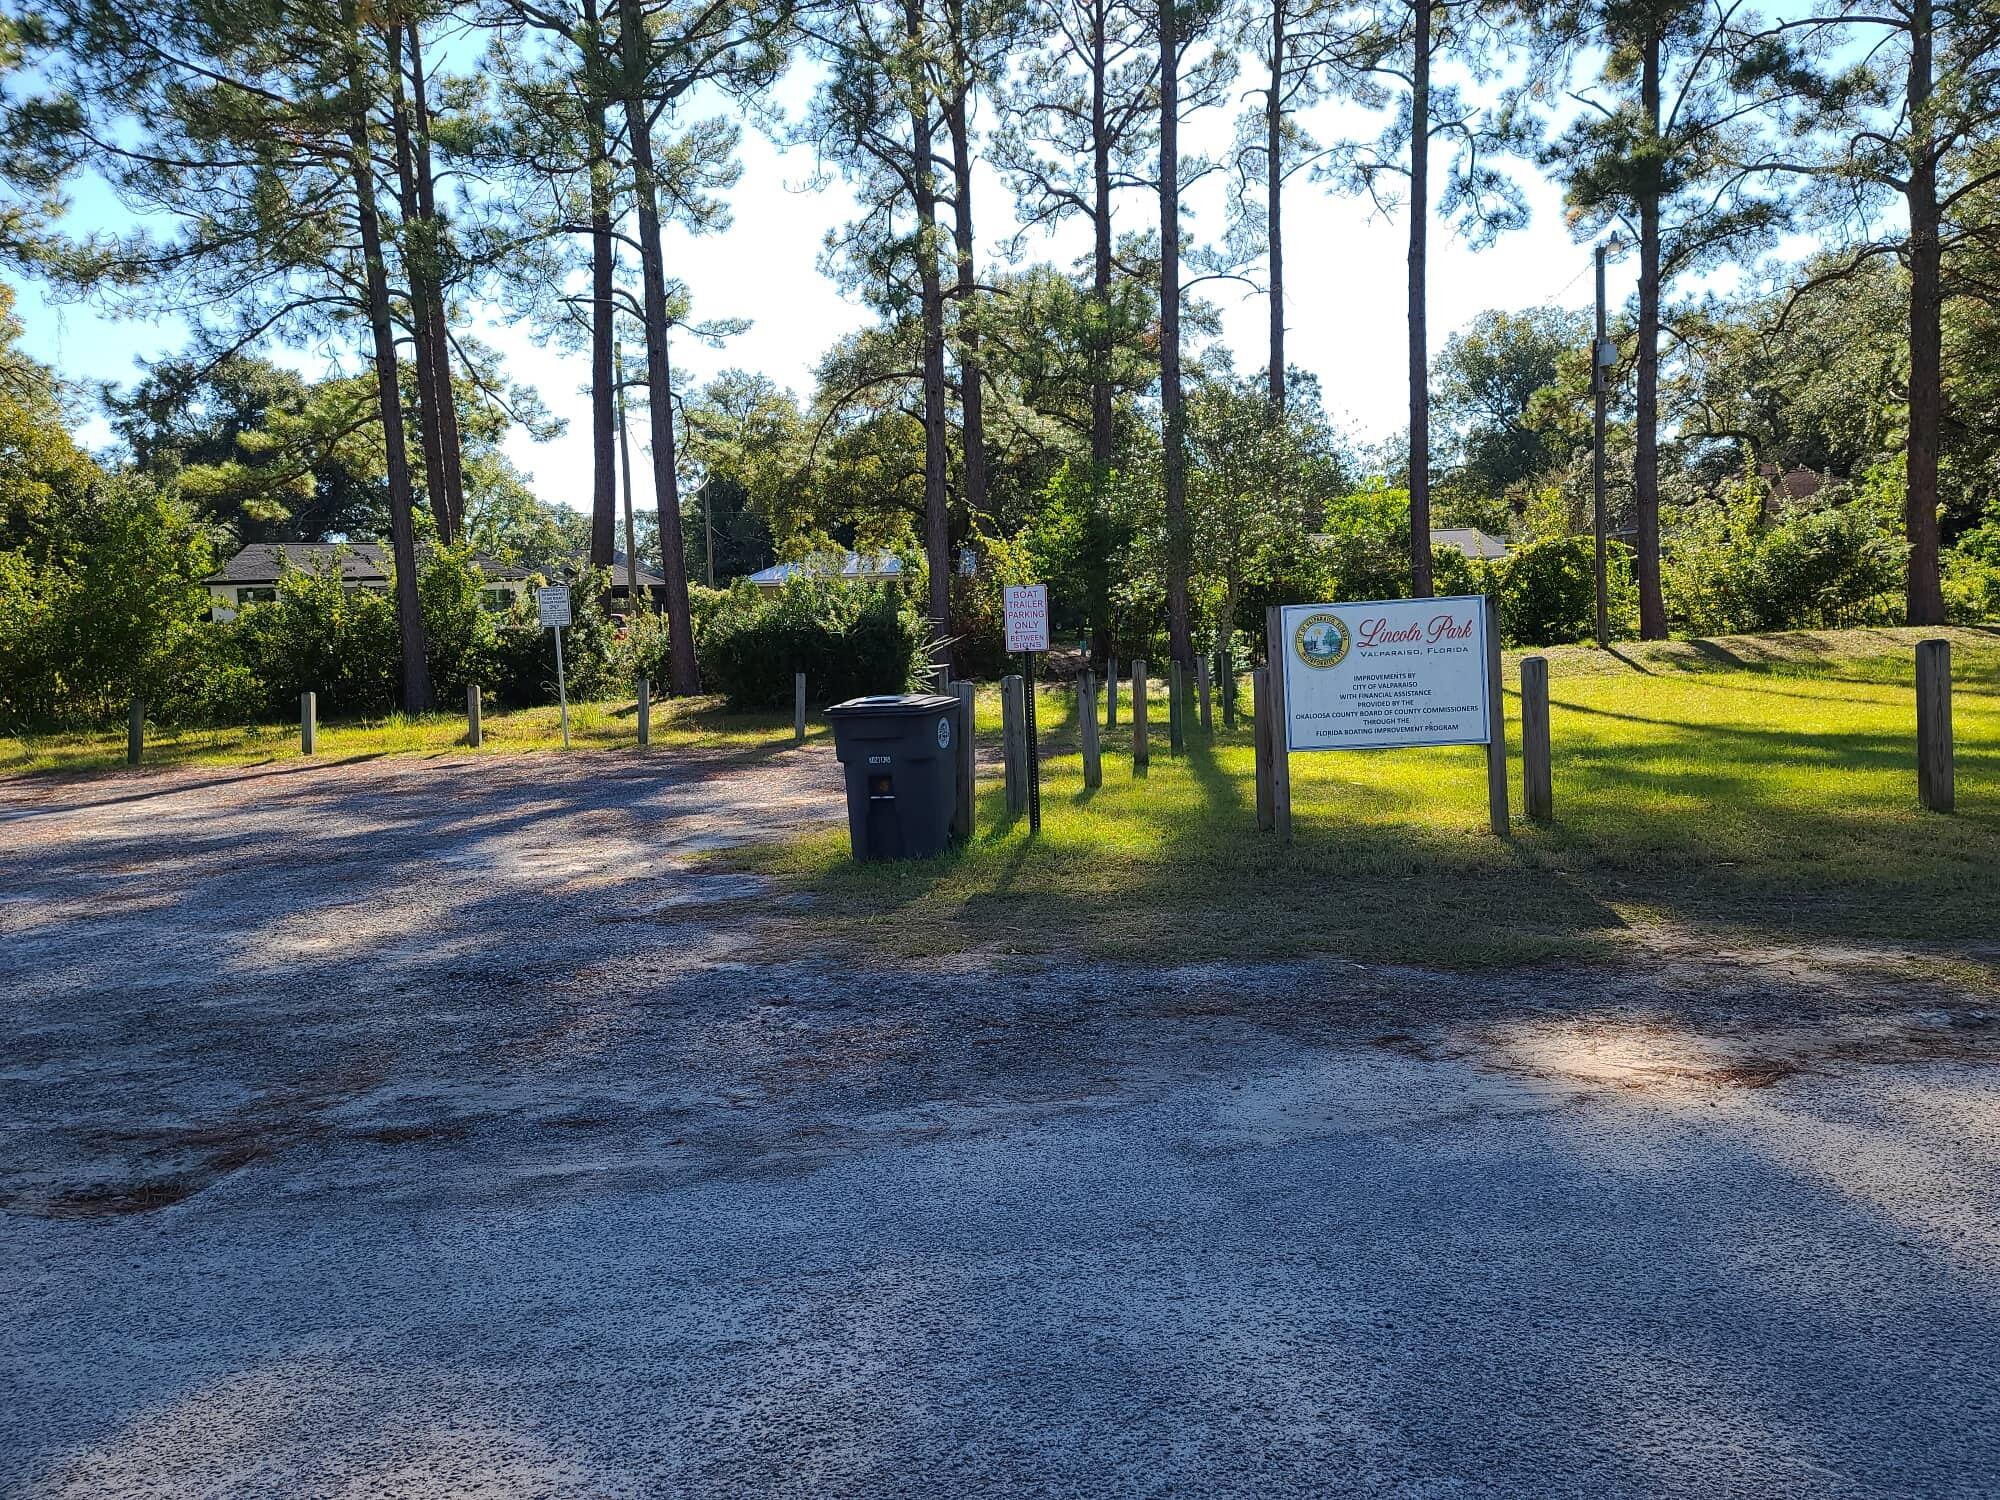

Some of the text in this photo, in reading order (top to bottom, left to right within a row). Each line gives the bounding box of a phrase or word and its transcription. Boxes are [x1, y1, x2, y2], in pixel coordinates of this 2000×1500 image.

[1013, 591, 1038, 599] BOAT
[1008, 600, 1044, 608] TRAILER
[1008, 610, 1044, 619] PARKING
[1014, 621, 1039, 629] ONLY
[1356, 615, 1473, 647] Lincoln Park
[1427, 647, 1469, 655] FLORIDA
[1353, 673, 1406, 681] IMPROVEMENTS
[1377, 681, 1418, 689] VALPARAISO
[1358, 691, 1393, 699] FINANCIAL
[1393, 689, 1432, 697] ASSISTANCE
[1357, 700, 1391, 708] PROVIDED
[1295, 712, 1331, 720] OKALOOSA
[1422, 705, 1479, 714] COMMISSIONERS
[1374, 725, 1424, 734] IMPROVEMENT
[1424, 724, 1459, 732] PROGRAM
